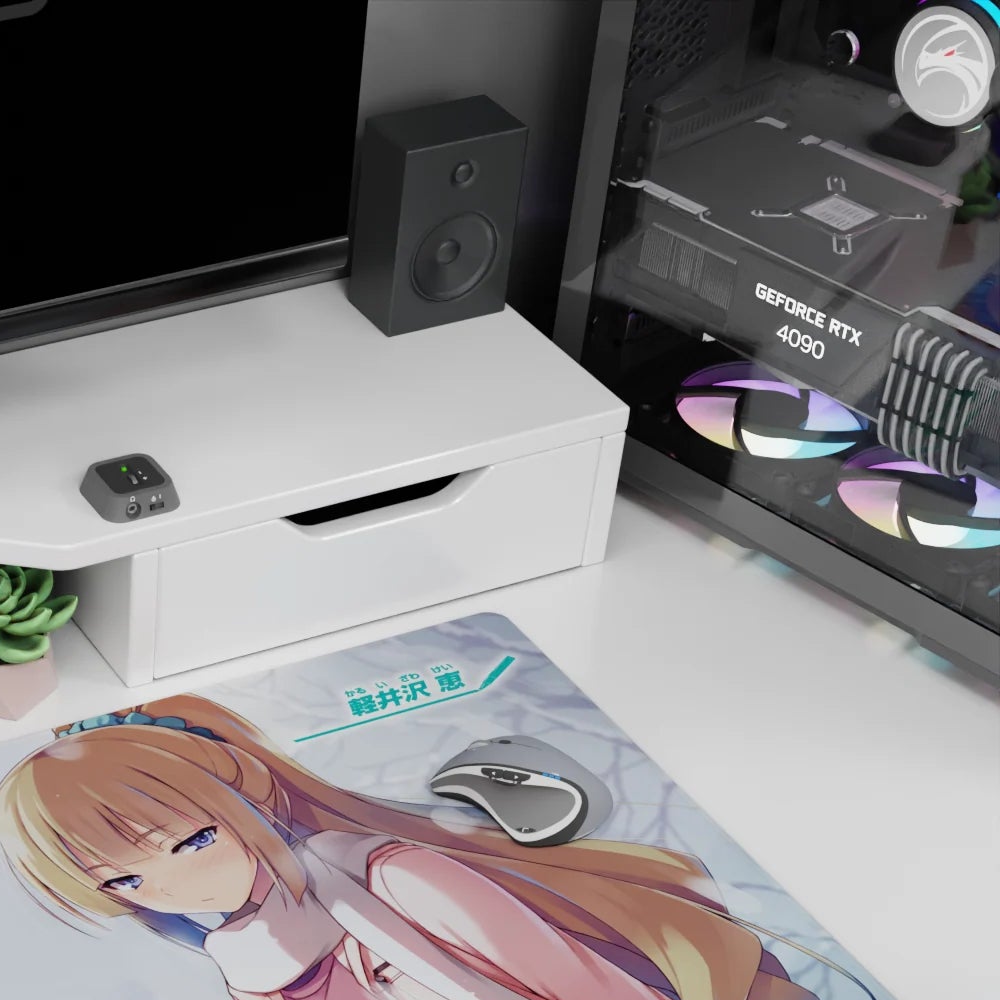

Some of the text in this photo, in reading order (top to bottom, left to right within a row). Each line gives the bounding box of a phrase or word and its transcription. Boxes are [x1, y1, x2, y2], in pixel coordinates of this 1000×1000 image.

[755, 282, 863, 347] GEFORCE RTX
[776, 325, 826, 360] 4090
[347, 679, 431, 717] 軽井沢
